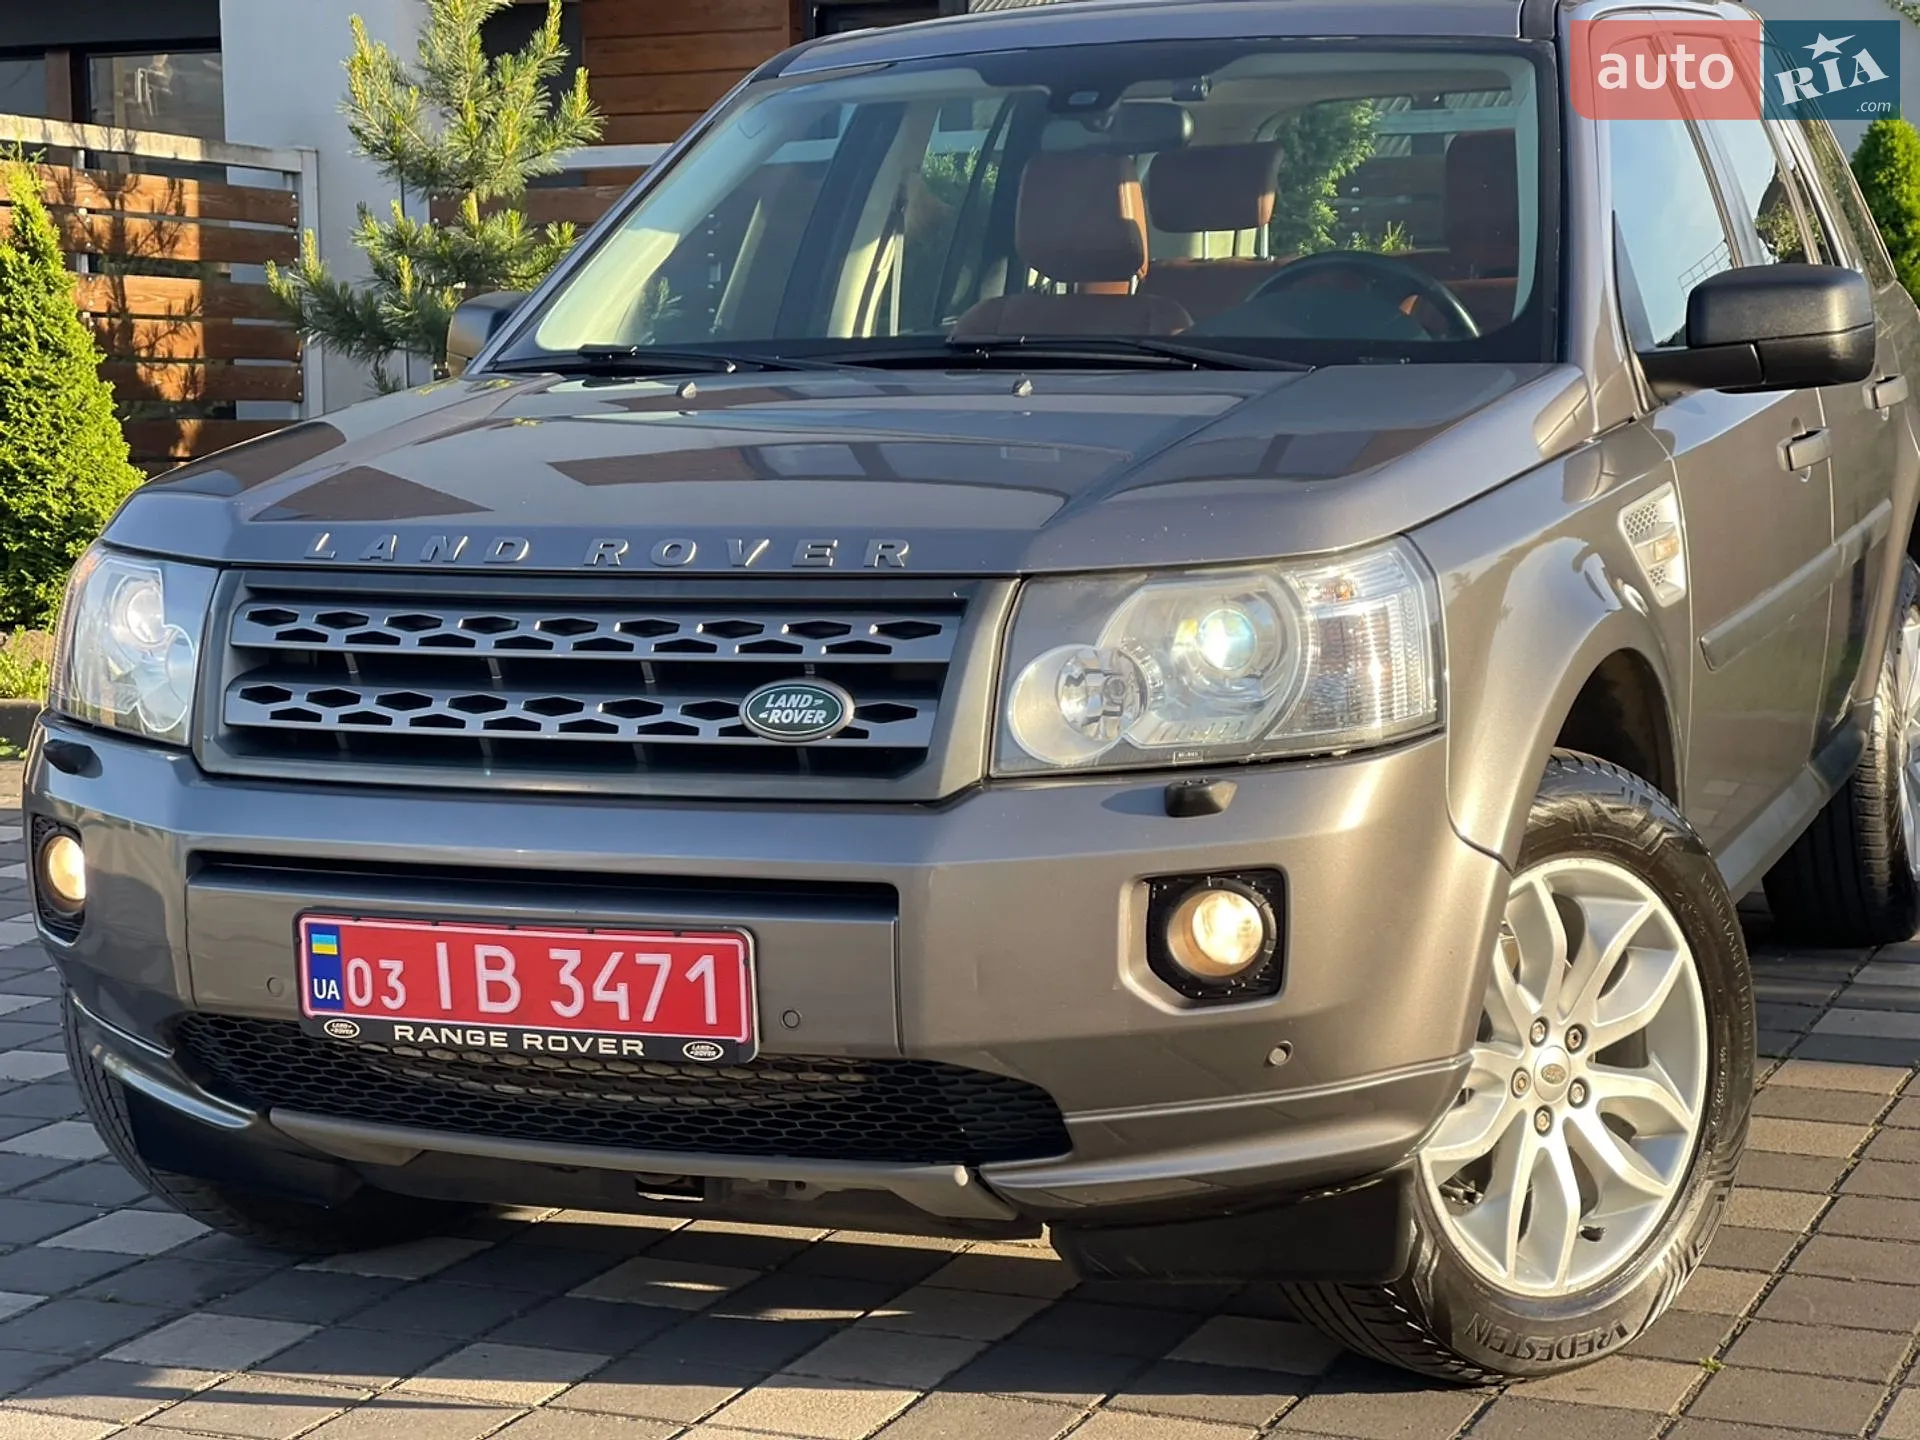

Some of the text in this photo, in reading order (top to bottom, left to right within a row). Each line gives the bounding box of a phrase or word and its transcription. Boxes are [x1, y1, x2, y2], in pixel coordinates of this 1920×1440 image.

[304, 531, 913, 568] LAND ROVER
[765, 694, 813, 708] LAND
[768, 709, 827, 724] ROVER
[313, 978, 341, 1000] UA
[346, 942, 718, 1025] 03 IB 3471
[393, 1024, 645, 1056] RANGE ROVER
[1463, 1312, 1630, 1363] VREDESTEIN
